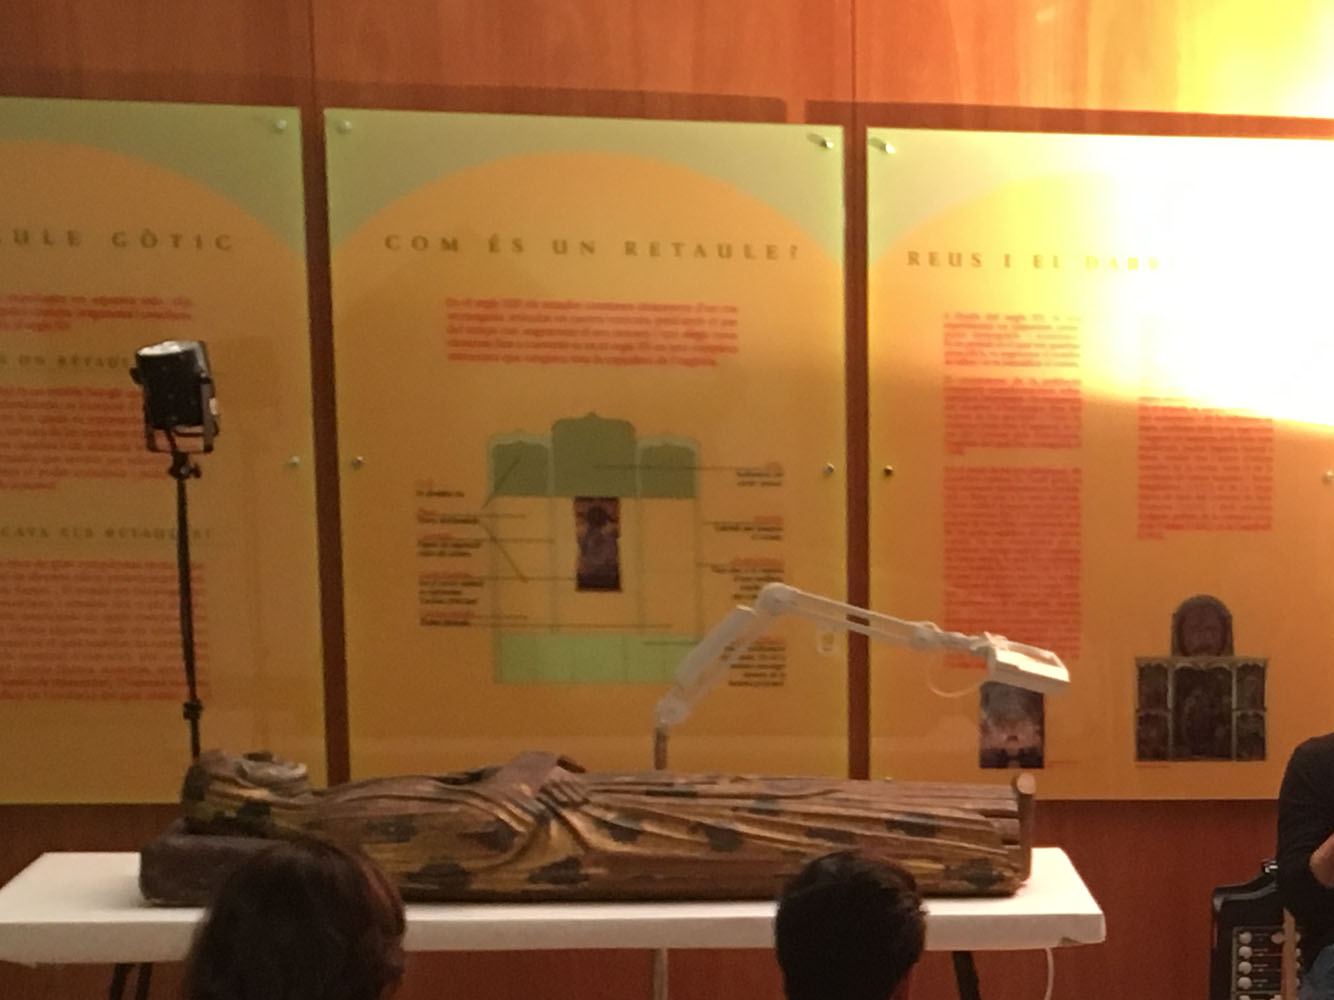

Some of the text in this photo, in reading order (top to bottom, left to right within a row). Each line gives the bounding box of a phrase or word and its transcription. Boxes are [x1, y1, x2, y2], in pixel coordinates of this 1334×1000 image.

[111, 227, 233, 250] GÒTIC
[384, 231, 800, 259] COM ÉS UN RETAULE?
[906, 250, 983, 269] REUS
[1003, 253, 1012, 269] I
